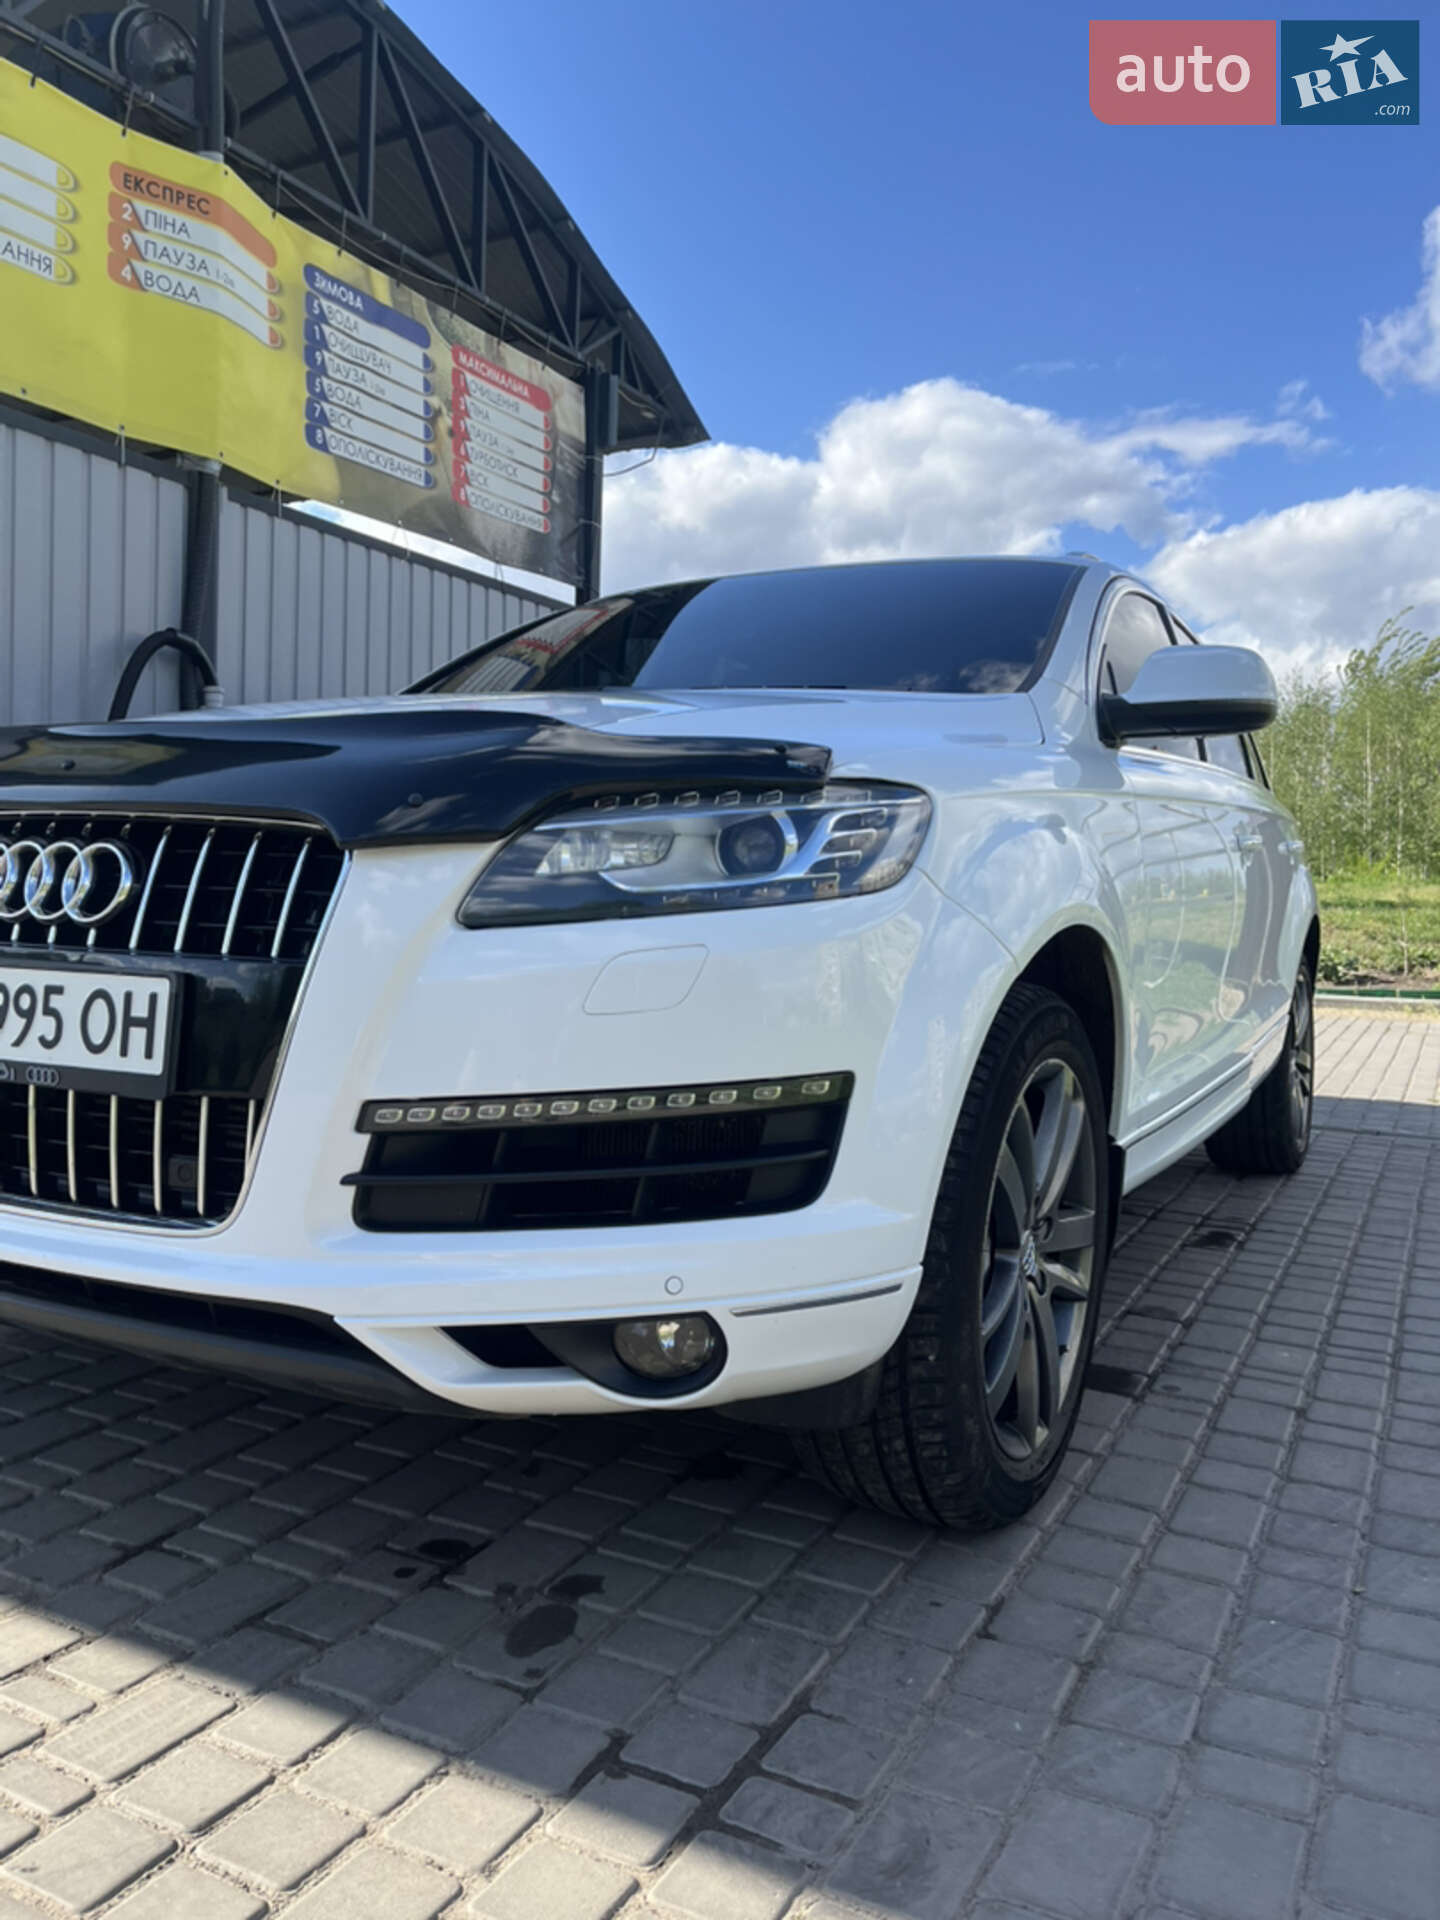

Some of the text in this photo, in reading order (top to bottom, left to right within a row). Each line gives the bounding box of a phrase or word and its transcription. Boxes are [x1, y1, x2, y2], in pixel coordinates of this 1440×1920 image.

[122, 171, 211, 216] ЕКСПРЕС
[121, 203, 191, 239] 2 ПІНА
[143, 239, 210, 276] ПАУЗА
[143, 270, 201, 302] ВОДА
[80, 988, 158, 1060] OH
